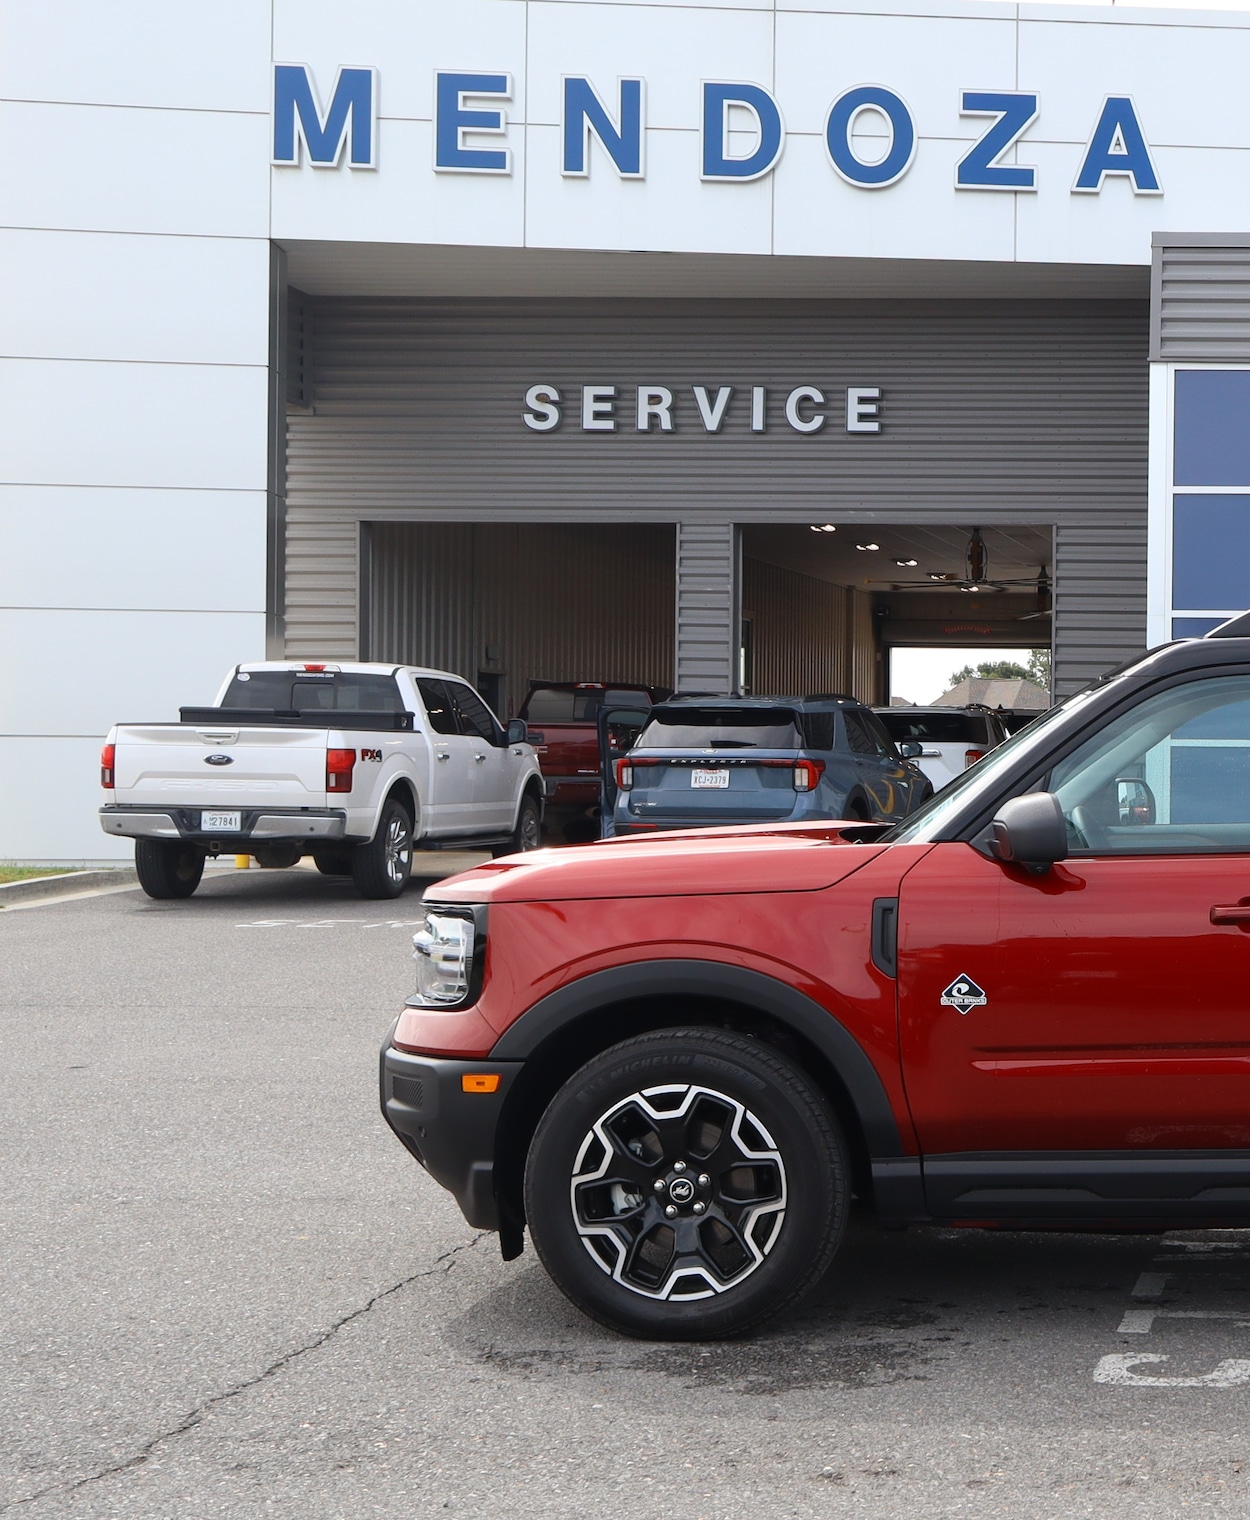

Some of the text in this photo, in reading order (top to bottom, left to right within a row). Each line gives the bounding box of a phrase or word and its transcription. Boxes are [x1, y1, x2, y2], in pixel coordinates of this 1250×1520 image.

[270, 62, 1164, 197] MENDOZA
[522, 383, 883, 435] SERVICE
[361, 748, 383, 761] FX4
[213, 817, 237, 826] 27841
[610, 1055, 691, 1080] MICHELIN
